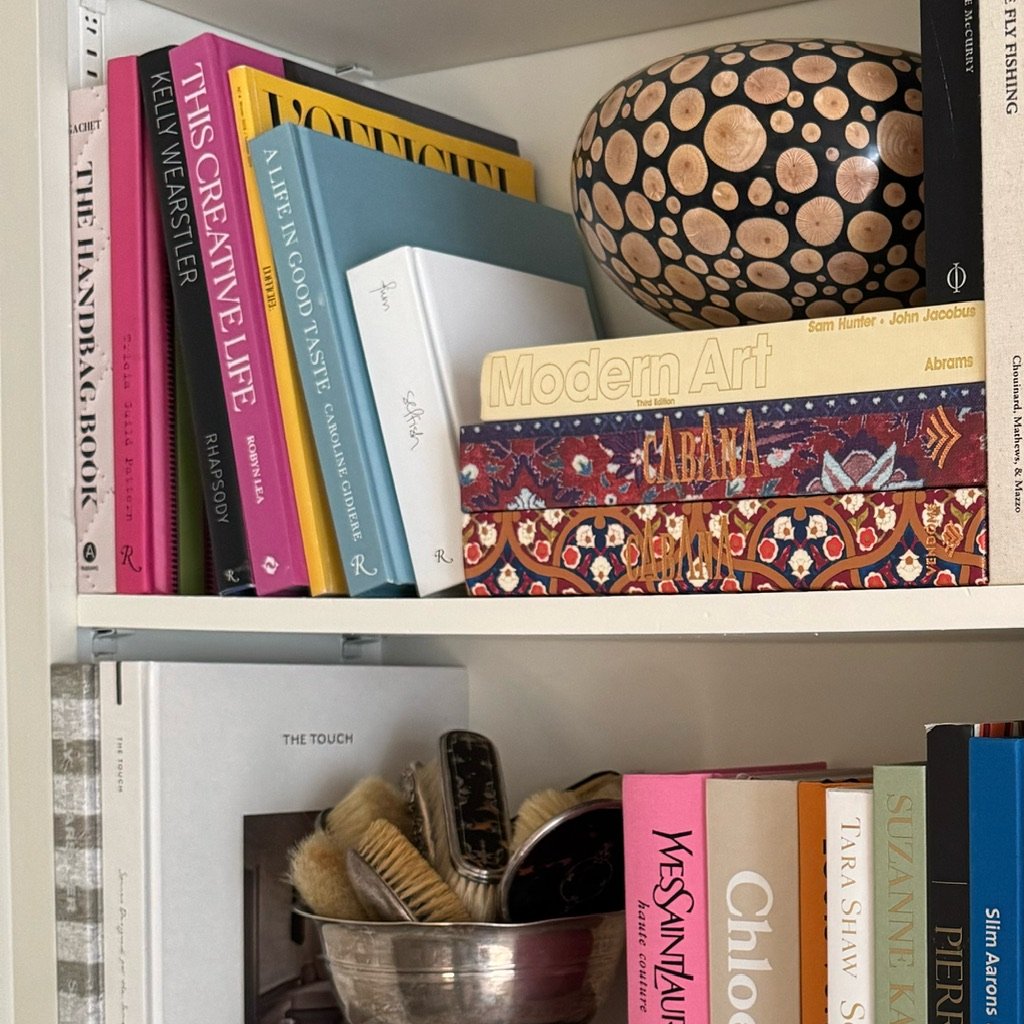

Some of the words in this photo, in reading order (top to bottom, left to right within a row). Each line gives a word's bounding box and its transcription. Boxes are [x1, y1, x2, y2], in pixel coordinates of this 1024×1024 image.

[964, 10, 975, 74] McCURRY
[1004, 8, 1017, 39] FLY
[150, 70, 179, 137] KELLY
[180, 62, 214, 151] THIS
[1004, 43, 1019, 116] FISHING
[264, 149, 279, 163] A
[76, 161, 94, 229] THE
[160, 142, 199, 287] WEARSTLER
[269, 166, 293, 220] LIFE
[194, 153, 244, 333] CREATIVE
[281, 222, 299, 248] IN
[287, 251, 315, 318] GOOD
[77, 238, 96, 403] HANDBAG
[807, 320, 835, 333] Sam
[837, 315, 877, 330] Hunter
[889, 312, 920, 326] John
[922, 305, 977, 323] Jacobus
[222, 333, 257, 413] LIFE
[304, 320, 331, 395] TASTE
[489, 347, 681, 408] Modern
[688, 333, 773, 394] Art
[924, 354, 974, 372] Abrams
[1012, 354, 1022, 413] Chouinard,
[79, 413, 98, 510] BOOK
[324, 403, 348, 478] CAROLINE
[341, 480, 363, 543] GIDIERE
[642, 408, 763, 485] CABANA
[1013, 415, 1023, 465] Mathews,
[205, 433, 230, 524] RHAPSODY
[254, 476, 265, 505] LEA
[1014, 480, 1023, 513] Mazzo
[283, 733, 307, 746] THE
[309, 732, 354, 745] TOUCH
[840, 816, 862, 889] TARA
[886, 793, 915, 970] SUZANNE
[637, 899, 650, 947] haute
[841, 898, 862, 979] SHAW
[985, 907, 1001, 948] Slim
[638, 952, 648, 1013] couture
[985, 951, 1000, 1016] Aarons
